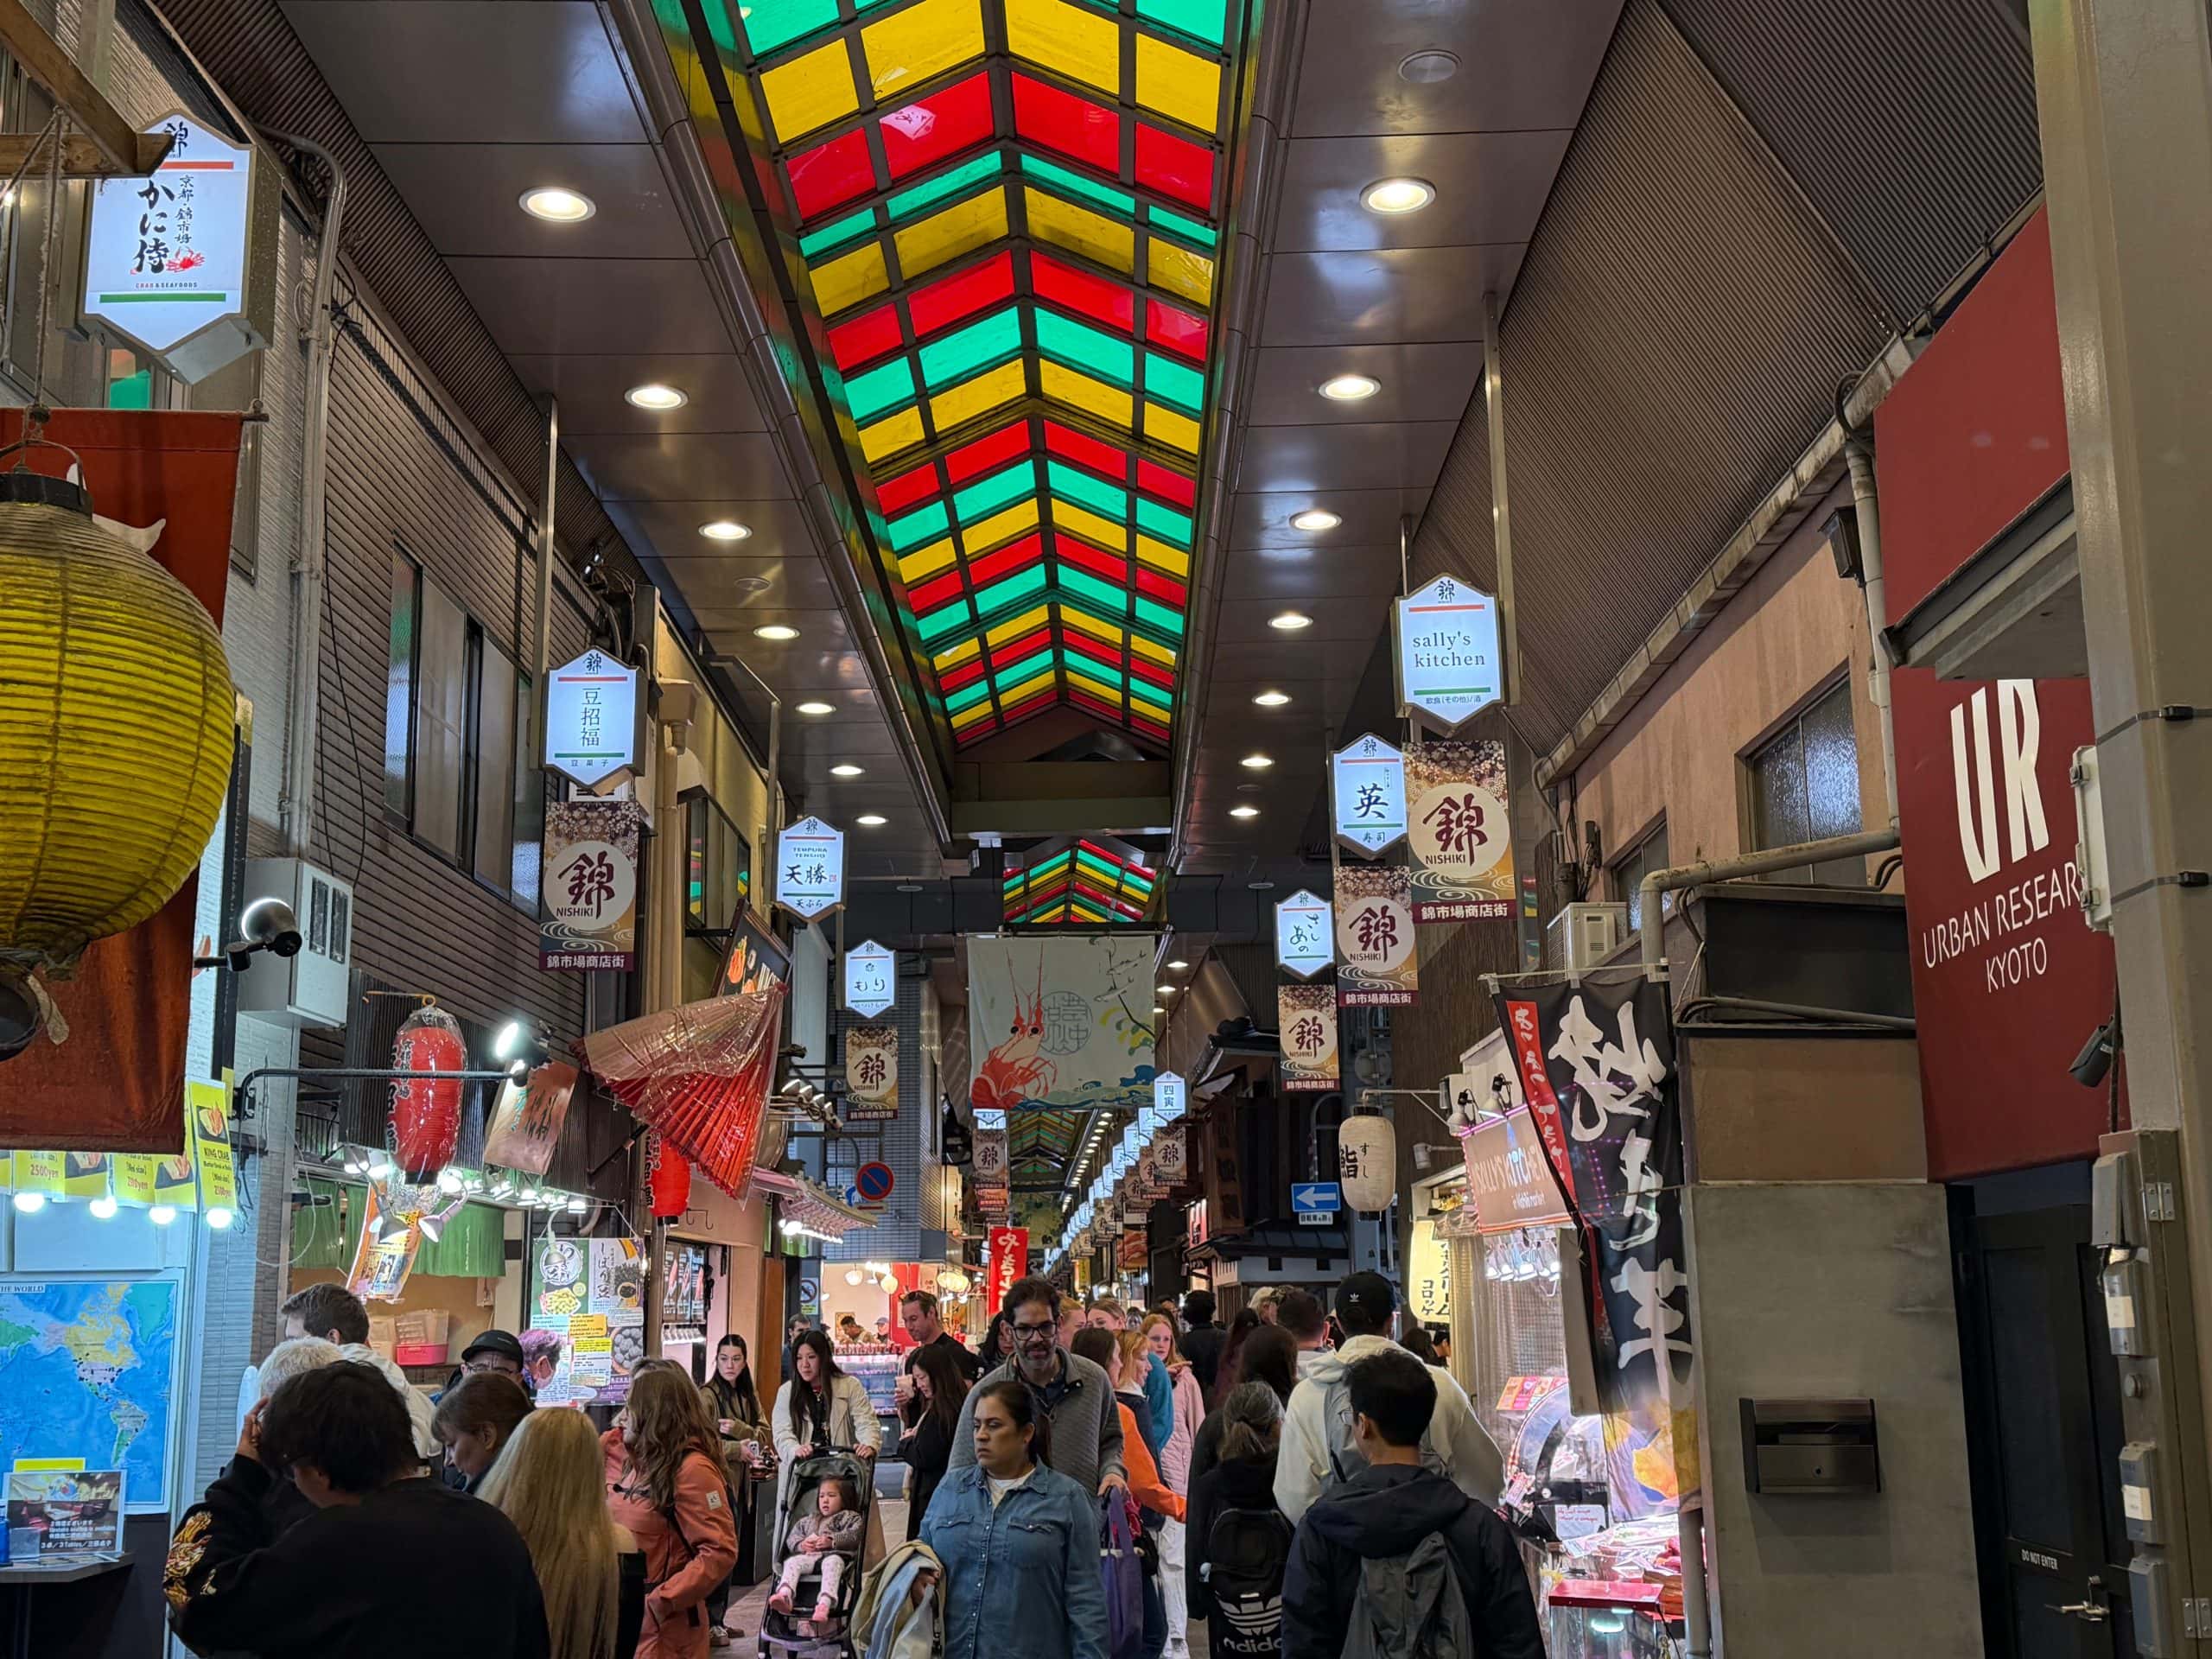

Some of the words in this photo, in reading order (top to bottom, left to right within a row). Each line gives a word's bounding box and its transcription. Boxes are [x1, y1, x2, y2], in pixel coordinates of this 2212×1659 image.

[133, 180, 175, 274] かに侍
[1413, 631, 1471, 650] sally's
[1415, 652, 1485, 668] kitchen
[581, 687, 601, 747] 豆招福
[1950, 678, 2050, 885] UR
[1353, 783, 1389, 819] 英
[1363, 831, 1385, 843] 寿司
[1422, 793, 1488, 867] 錦
[782, 862, 828, 886] 天勝
[1426, 854, 1466, 865] NISHIKI
[557, 850, 615, 919] 錦
[556, 907, 594, 918] NISHIKI
[796, 899, 823, 908] 天ぷら
[1421, 904, 1508, 920] 錦市場商店街
[1923, 901, 1990, 969] URBAN
[1995, 861, 2082, 936] RESEAR
[1349, 905, 1398, 963] 錦
[546, 955, 625, 969] 錦市場商店街
[1350, 952, 1381, 962] NISHIKI
[1986, 938, 2048, 993] KYOTO
[1345, 993, 1411, 1005] 錦市場商店街
[1288, 1015, 1325, 1058] 錦
[854, 1052, 887, 1091] 錦
[1359, 1142, 1370, 1179] すし
[1421, 1279, 1434, 1316] コロッケ
[2022, 1548, 2030, 1561] DO
[2030, 1551, 2040, 1566] NOT
[2041, 1554, 2058, 1570] ENTER
[1224, 1637, 1282, 1653] adida
